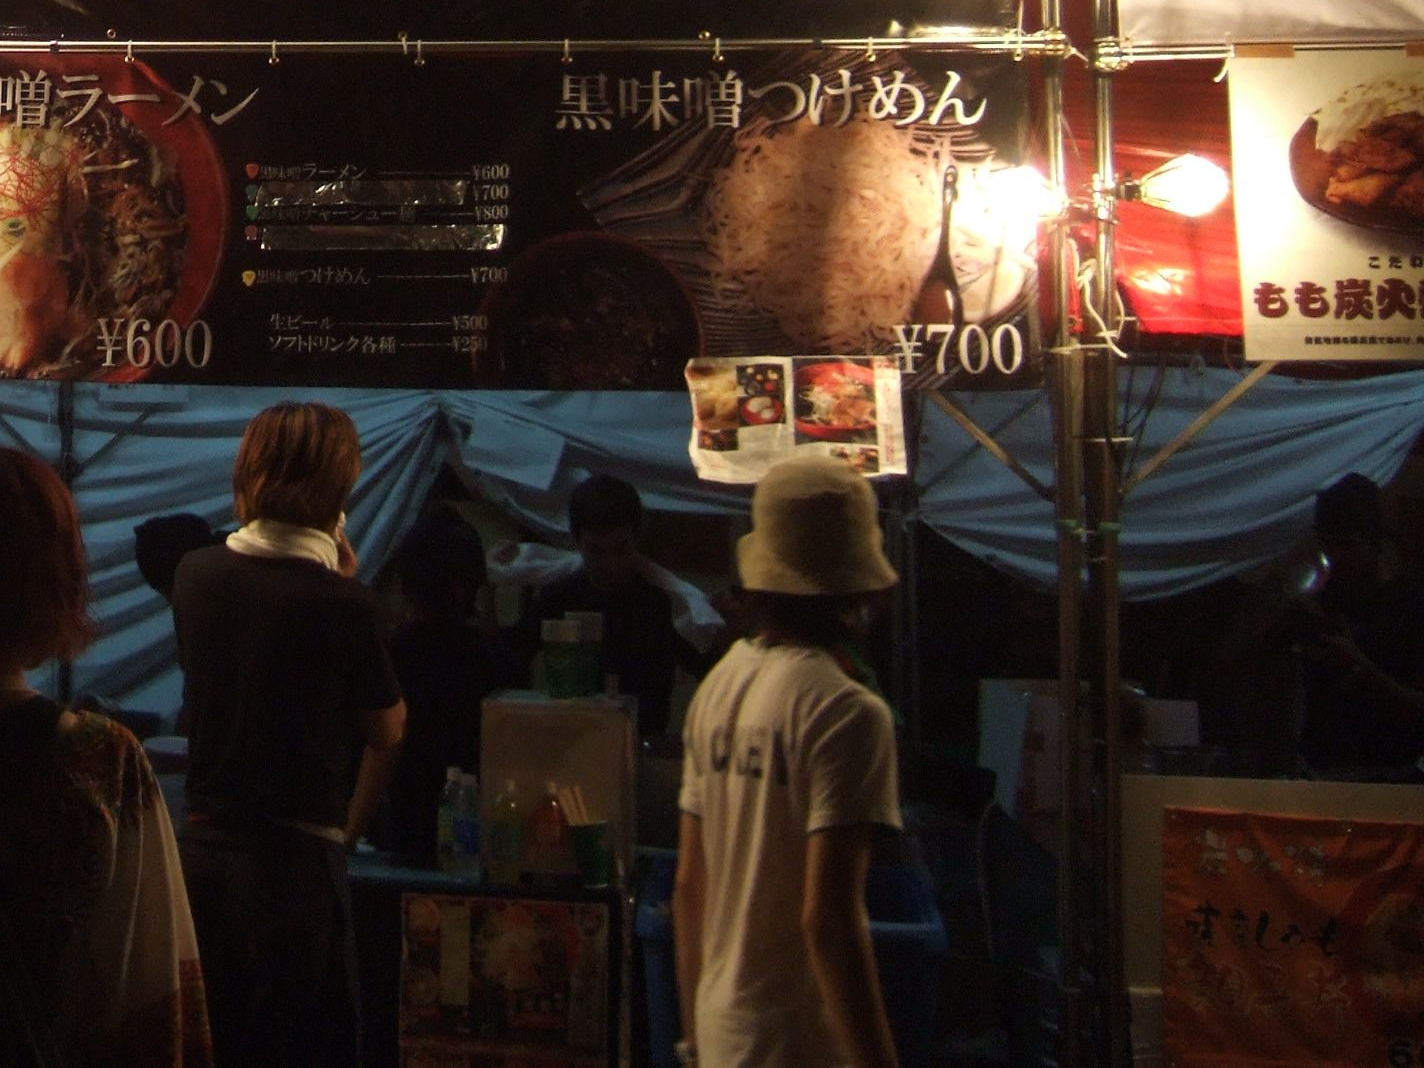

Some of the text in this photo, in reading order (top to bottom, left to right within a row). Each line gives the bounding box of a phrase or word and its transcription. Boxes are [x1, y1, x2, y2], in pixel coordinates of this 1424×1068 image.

[554, 68, 988, 132] 黒味噌つけめん
[1253, 277, 1424, 321] もも炭火
[96, 317, 214, 370] ¥600
[892, 323, 1023, 375] ¥700
